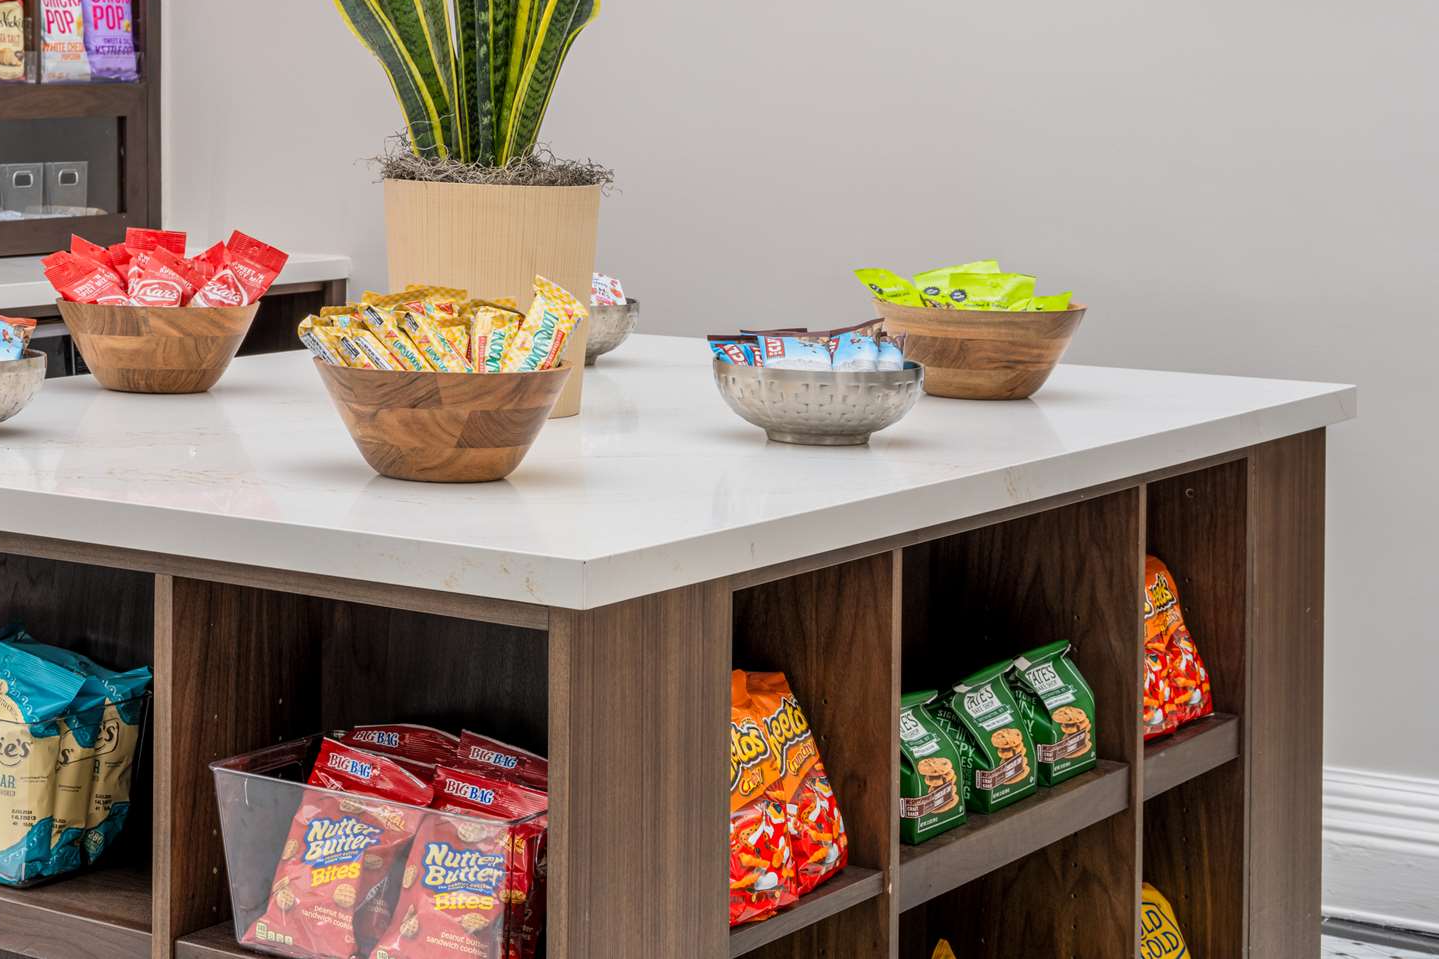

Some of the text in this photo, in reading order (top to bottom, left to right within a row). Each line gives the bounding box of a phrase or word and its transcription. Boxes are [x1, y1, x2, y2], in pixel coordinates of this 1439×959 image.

[45, 10, 74, 34] POP
[92, 5, 124, 31] POP
[376, 731, 399, 747] BAG
[328, 753, 372, 779] BIG BAG
[470, 746, 517, 768] BIG BAG
[445, 779, 495, 805] BIG BAG
[307, 818, 380, 841] Nutter
[305, 834, 377, 860] Butter
[426, 843, 504, 867] Nutter
[311, 862, 360, 888] Bites
[425, 865, 503, 886] Butter
[434, 892, 494, 911] Bites
